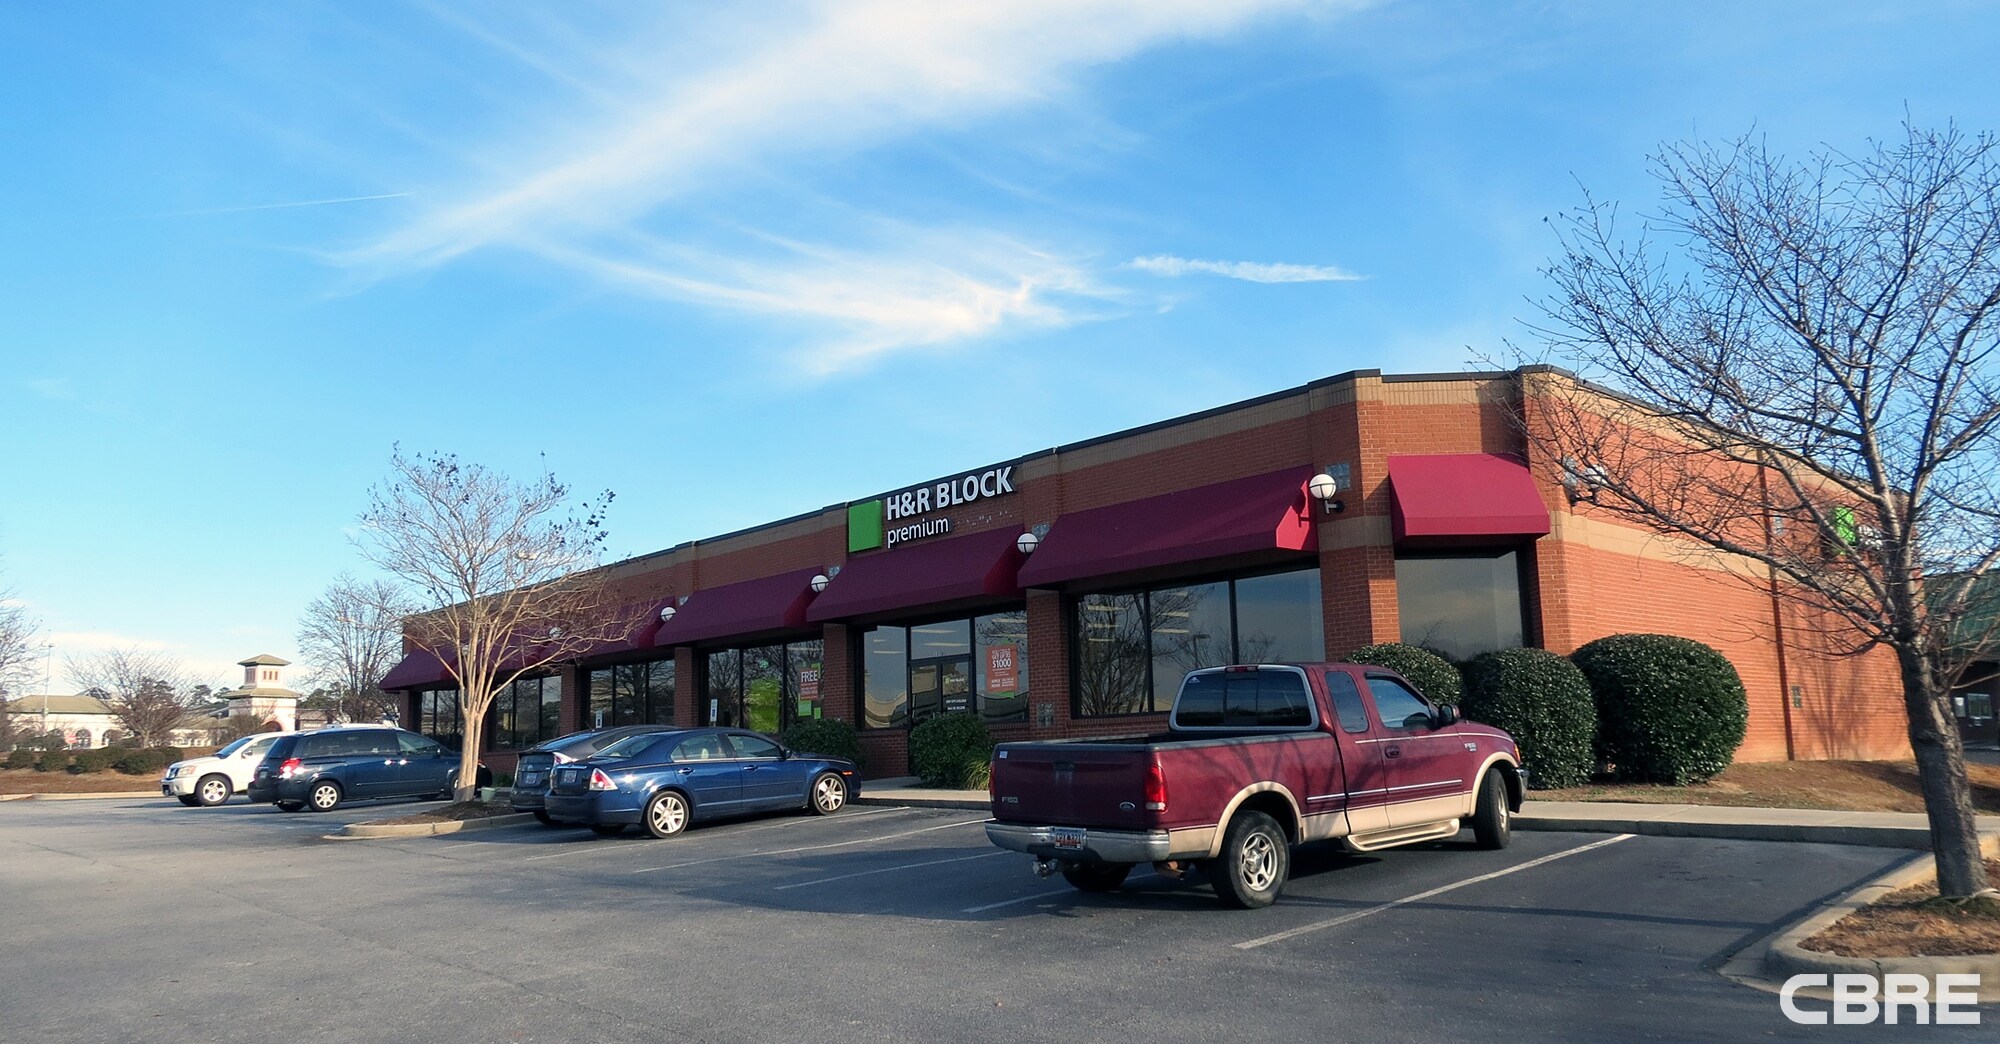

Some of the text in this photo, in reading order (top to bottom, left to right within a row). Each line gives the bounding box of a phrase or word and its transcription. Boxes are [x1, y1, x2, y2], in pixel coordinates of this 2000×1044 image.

[886, 466, 1014, 520] H&R BLOCK
[887, 517, 949, 549] premium
[992, 659, 1012, 668] $1000
[801, 670, 818, 682] FREE
